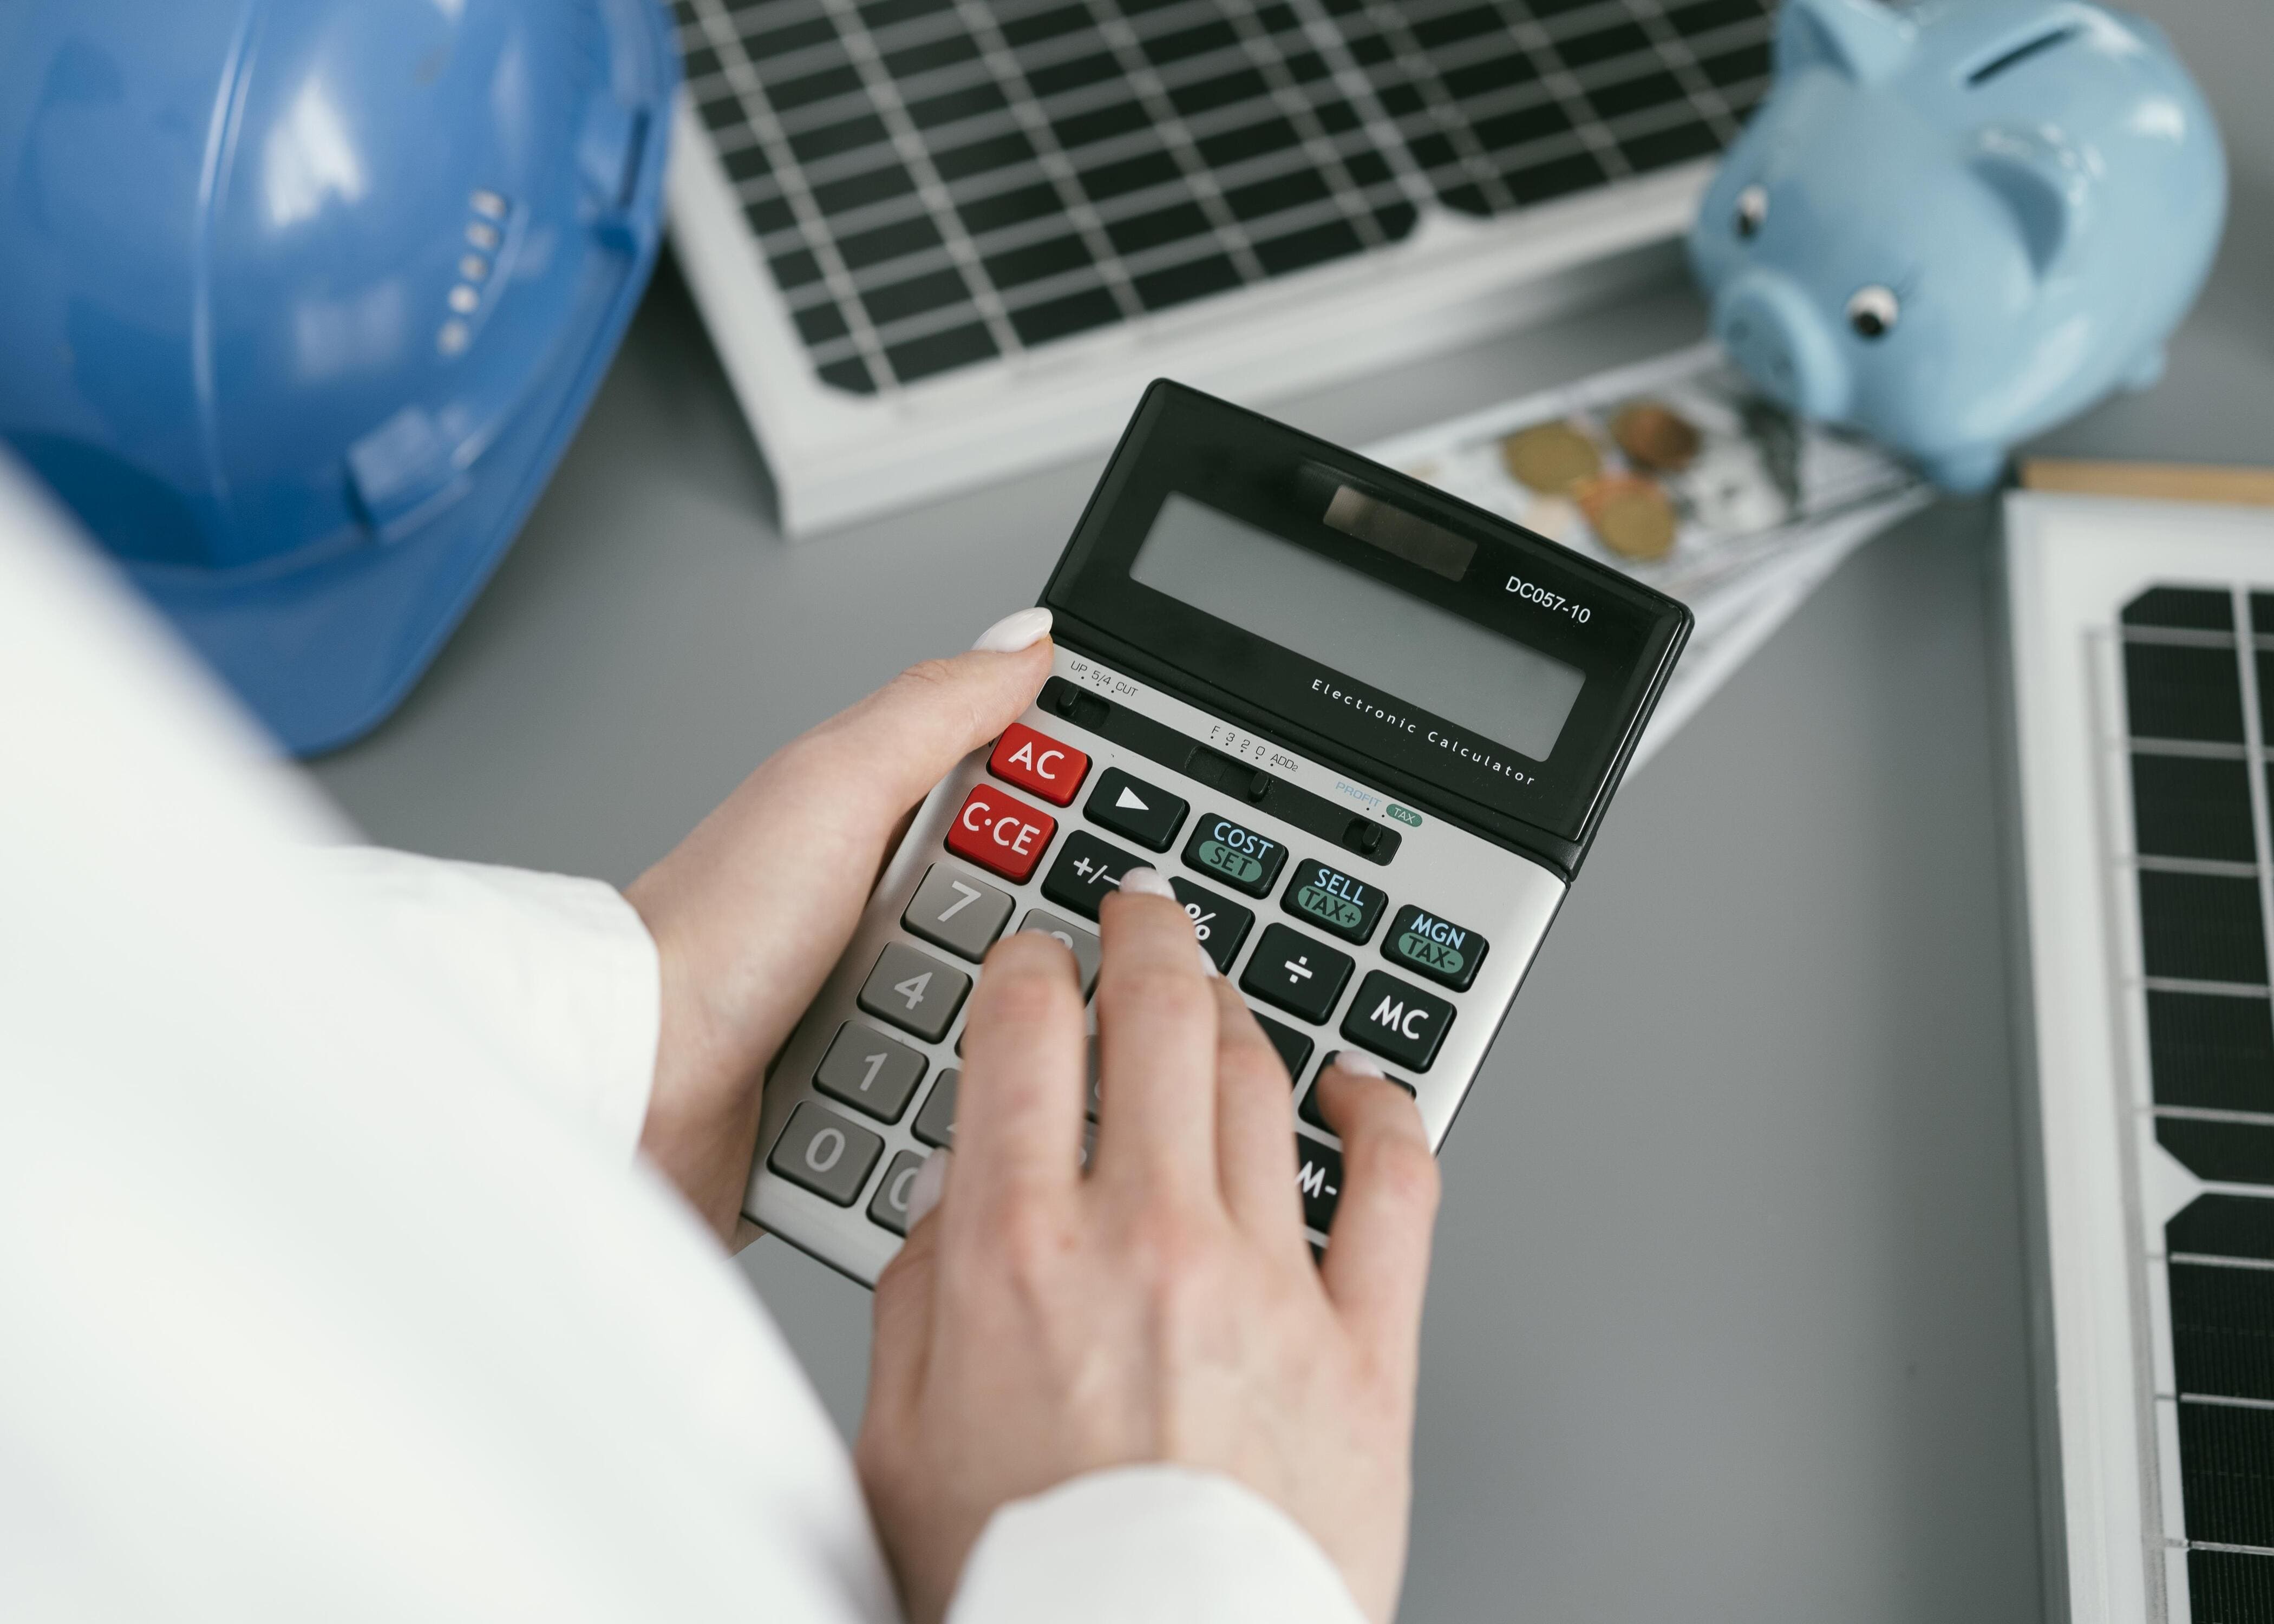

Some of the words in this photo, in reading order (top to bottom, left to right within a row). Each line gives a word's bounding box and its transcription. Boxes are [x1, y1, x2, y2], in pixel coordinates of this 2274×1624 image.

[1506, 576, 1591, 624] DC057-10
[1071, 660, 1088, 672] UP
[1092, 670, 1111, 685] 5/4
[1116, 682, 1138, 696] CUT
[1212, 725, 1220, 734] F
[1226, 732, 1235, 742] 3
[1241, 739, 1250, 749] 2
[1256, 746, 1265, 756] 0
[1312, 679, 1416, 733] Electronic
[1428, 731, 1535, 785] Calculator
[1008, 742, 1064, 780] AC
[1335, 782, 1382, 807] PROFIT
[1394, 807, 1415, 824] TAX
[1214, 822, 1273, 859] COST
[1210, 847, 1253, 878] SET
[938, 881, 982, 922] 7
[1304, 888, 1356, 924] TAX+
[1315, 868, 1364, 906] SELL
[1184, 903, 1216, 940] %
[1410, 913, 1465, 950] MGN
[1407, 936, 1455, 968] TAX-
[894, 972, 933, 1010] 4
[1370, 995, 1429, 1039] MC
[860, 1052, 887, 1091] 1
[805, 1128, 845, 1173] 0
